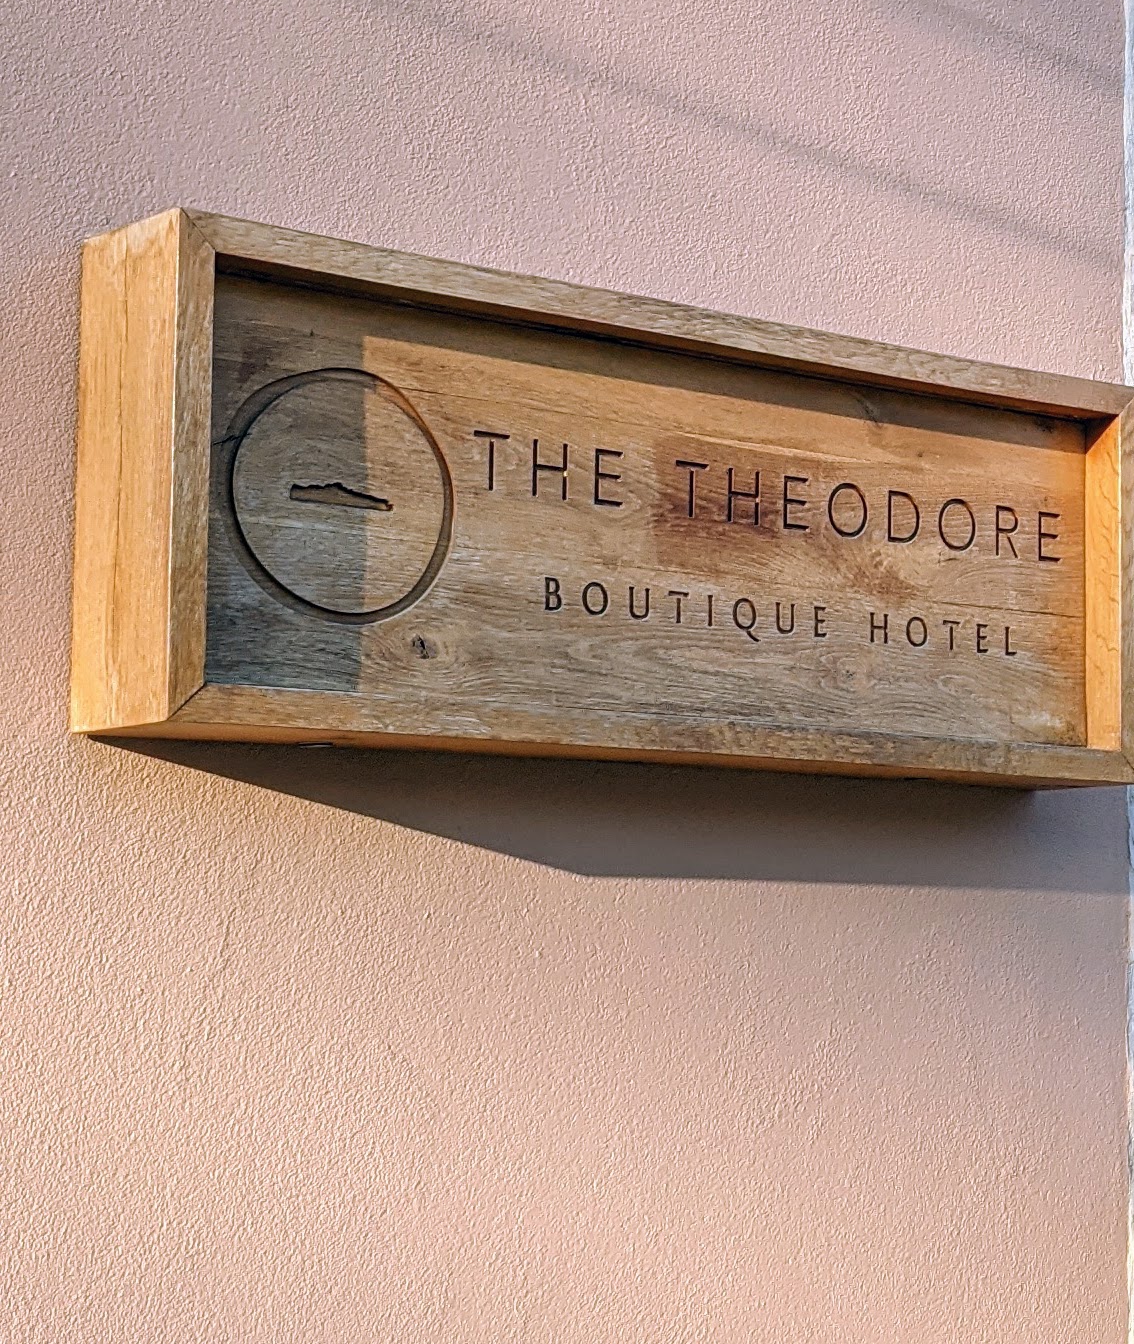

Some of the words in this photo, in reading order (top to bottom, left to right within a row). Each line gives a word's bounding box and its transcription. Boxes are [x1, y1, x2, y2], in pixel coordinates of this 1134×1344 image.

[474, 431, 624, 507] THE
[675, 460, 1062, 563] THEODORE
[545, 576, 828, 640] BOUTIQUE
[869, 612, 1018, 656] HOTEL
